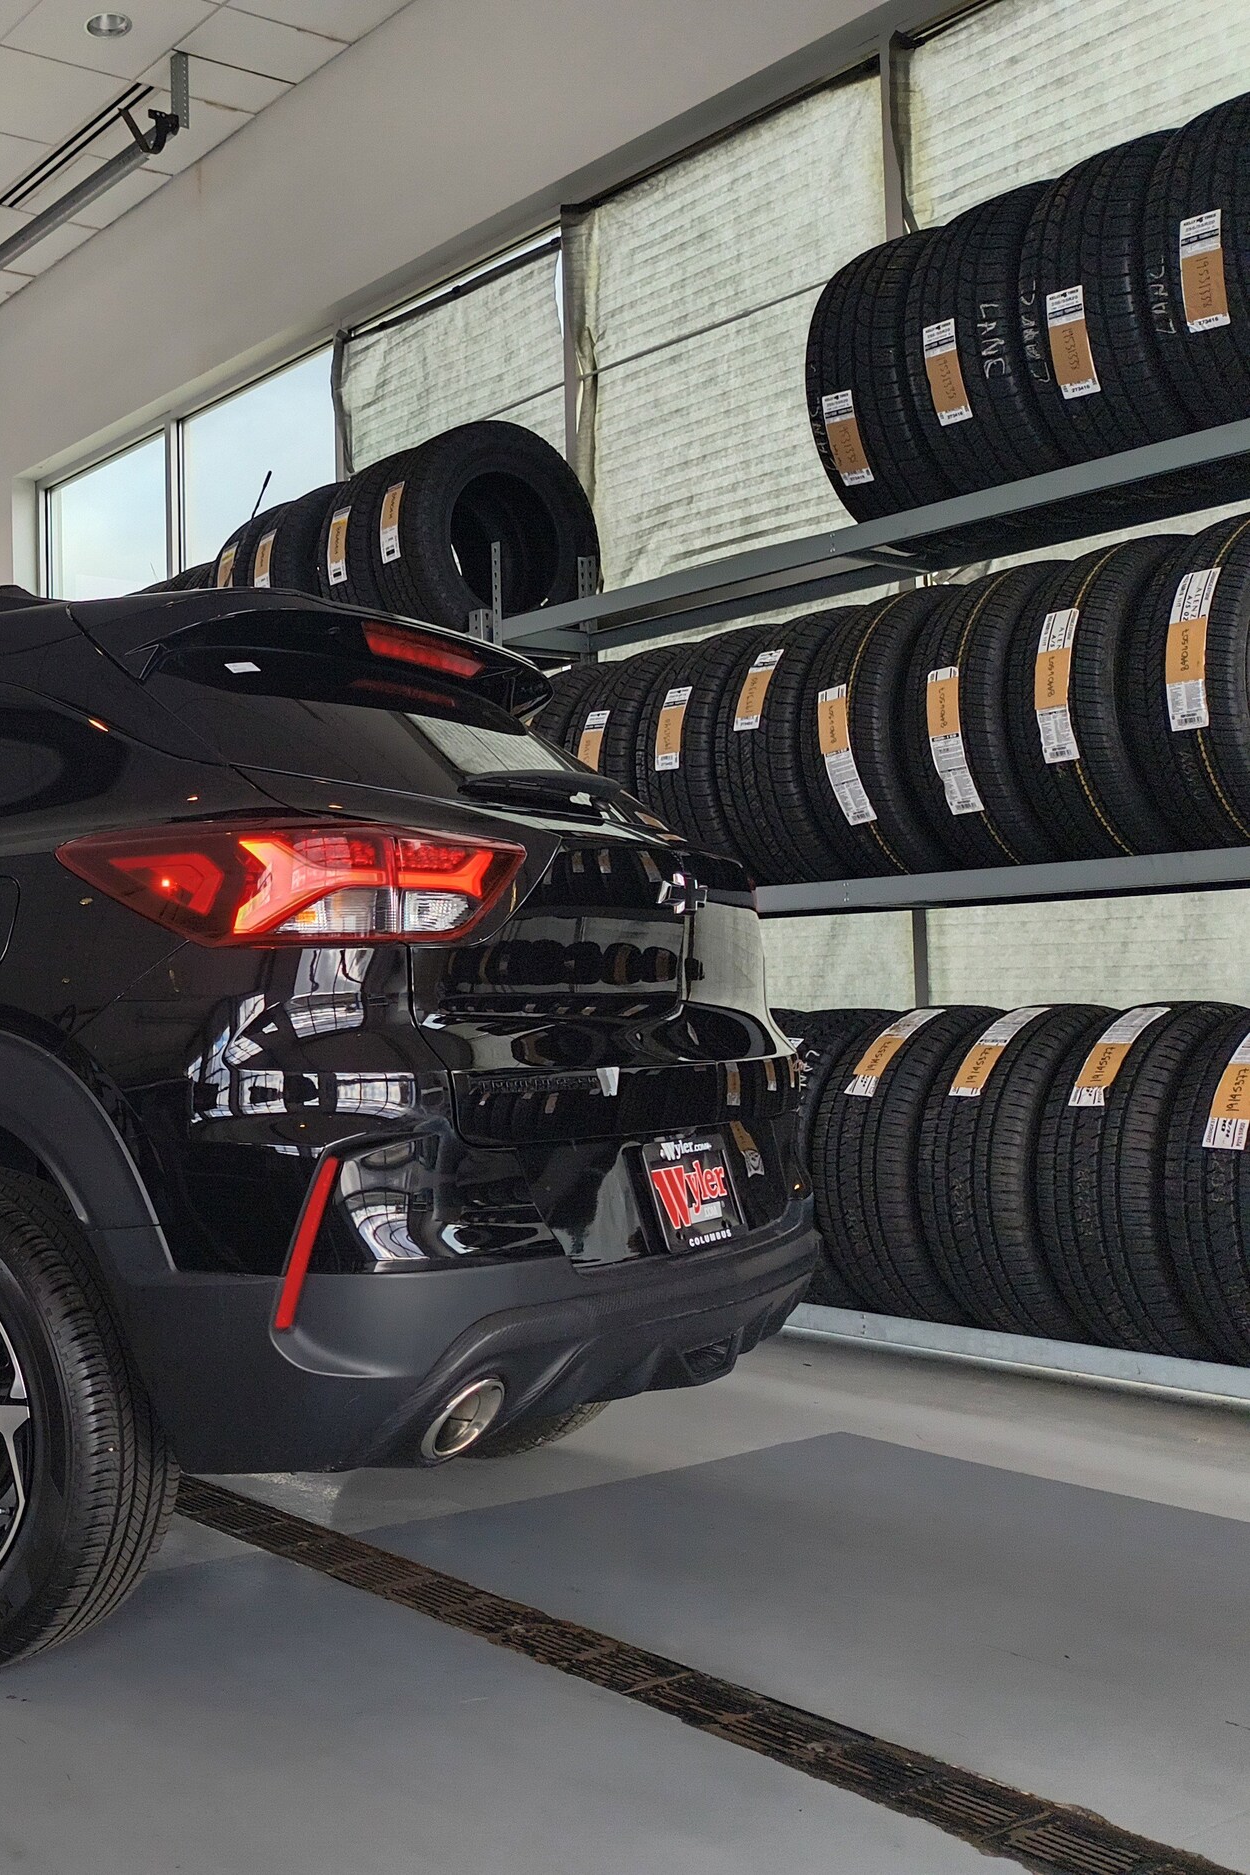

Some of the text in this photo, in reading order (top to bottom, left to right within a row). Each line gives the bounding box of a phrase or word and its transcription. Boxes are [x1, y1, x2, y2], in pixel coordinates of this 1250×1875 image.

[1226, 1067, 1250, 1112] 19145377
[651, 1160, 728, 1230] Wyler
[689, 1229, 733, 1247] COLUMBUS
